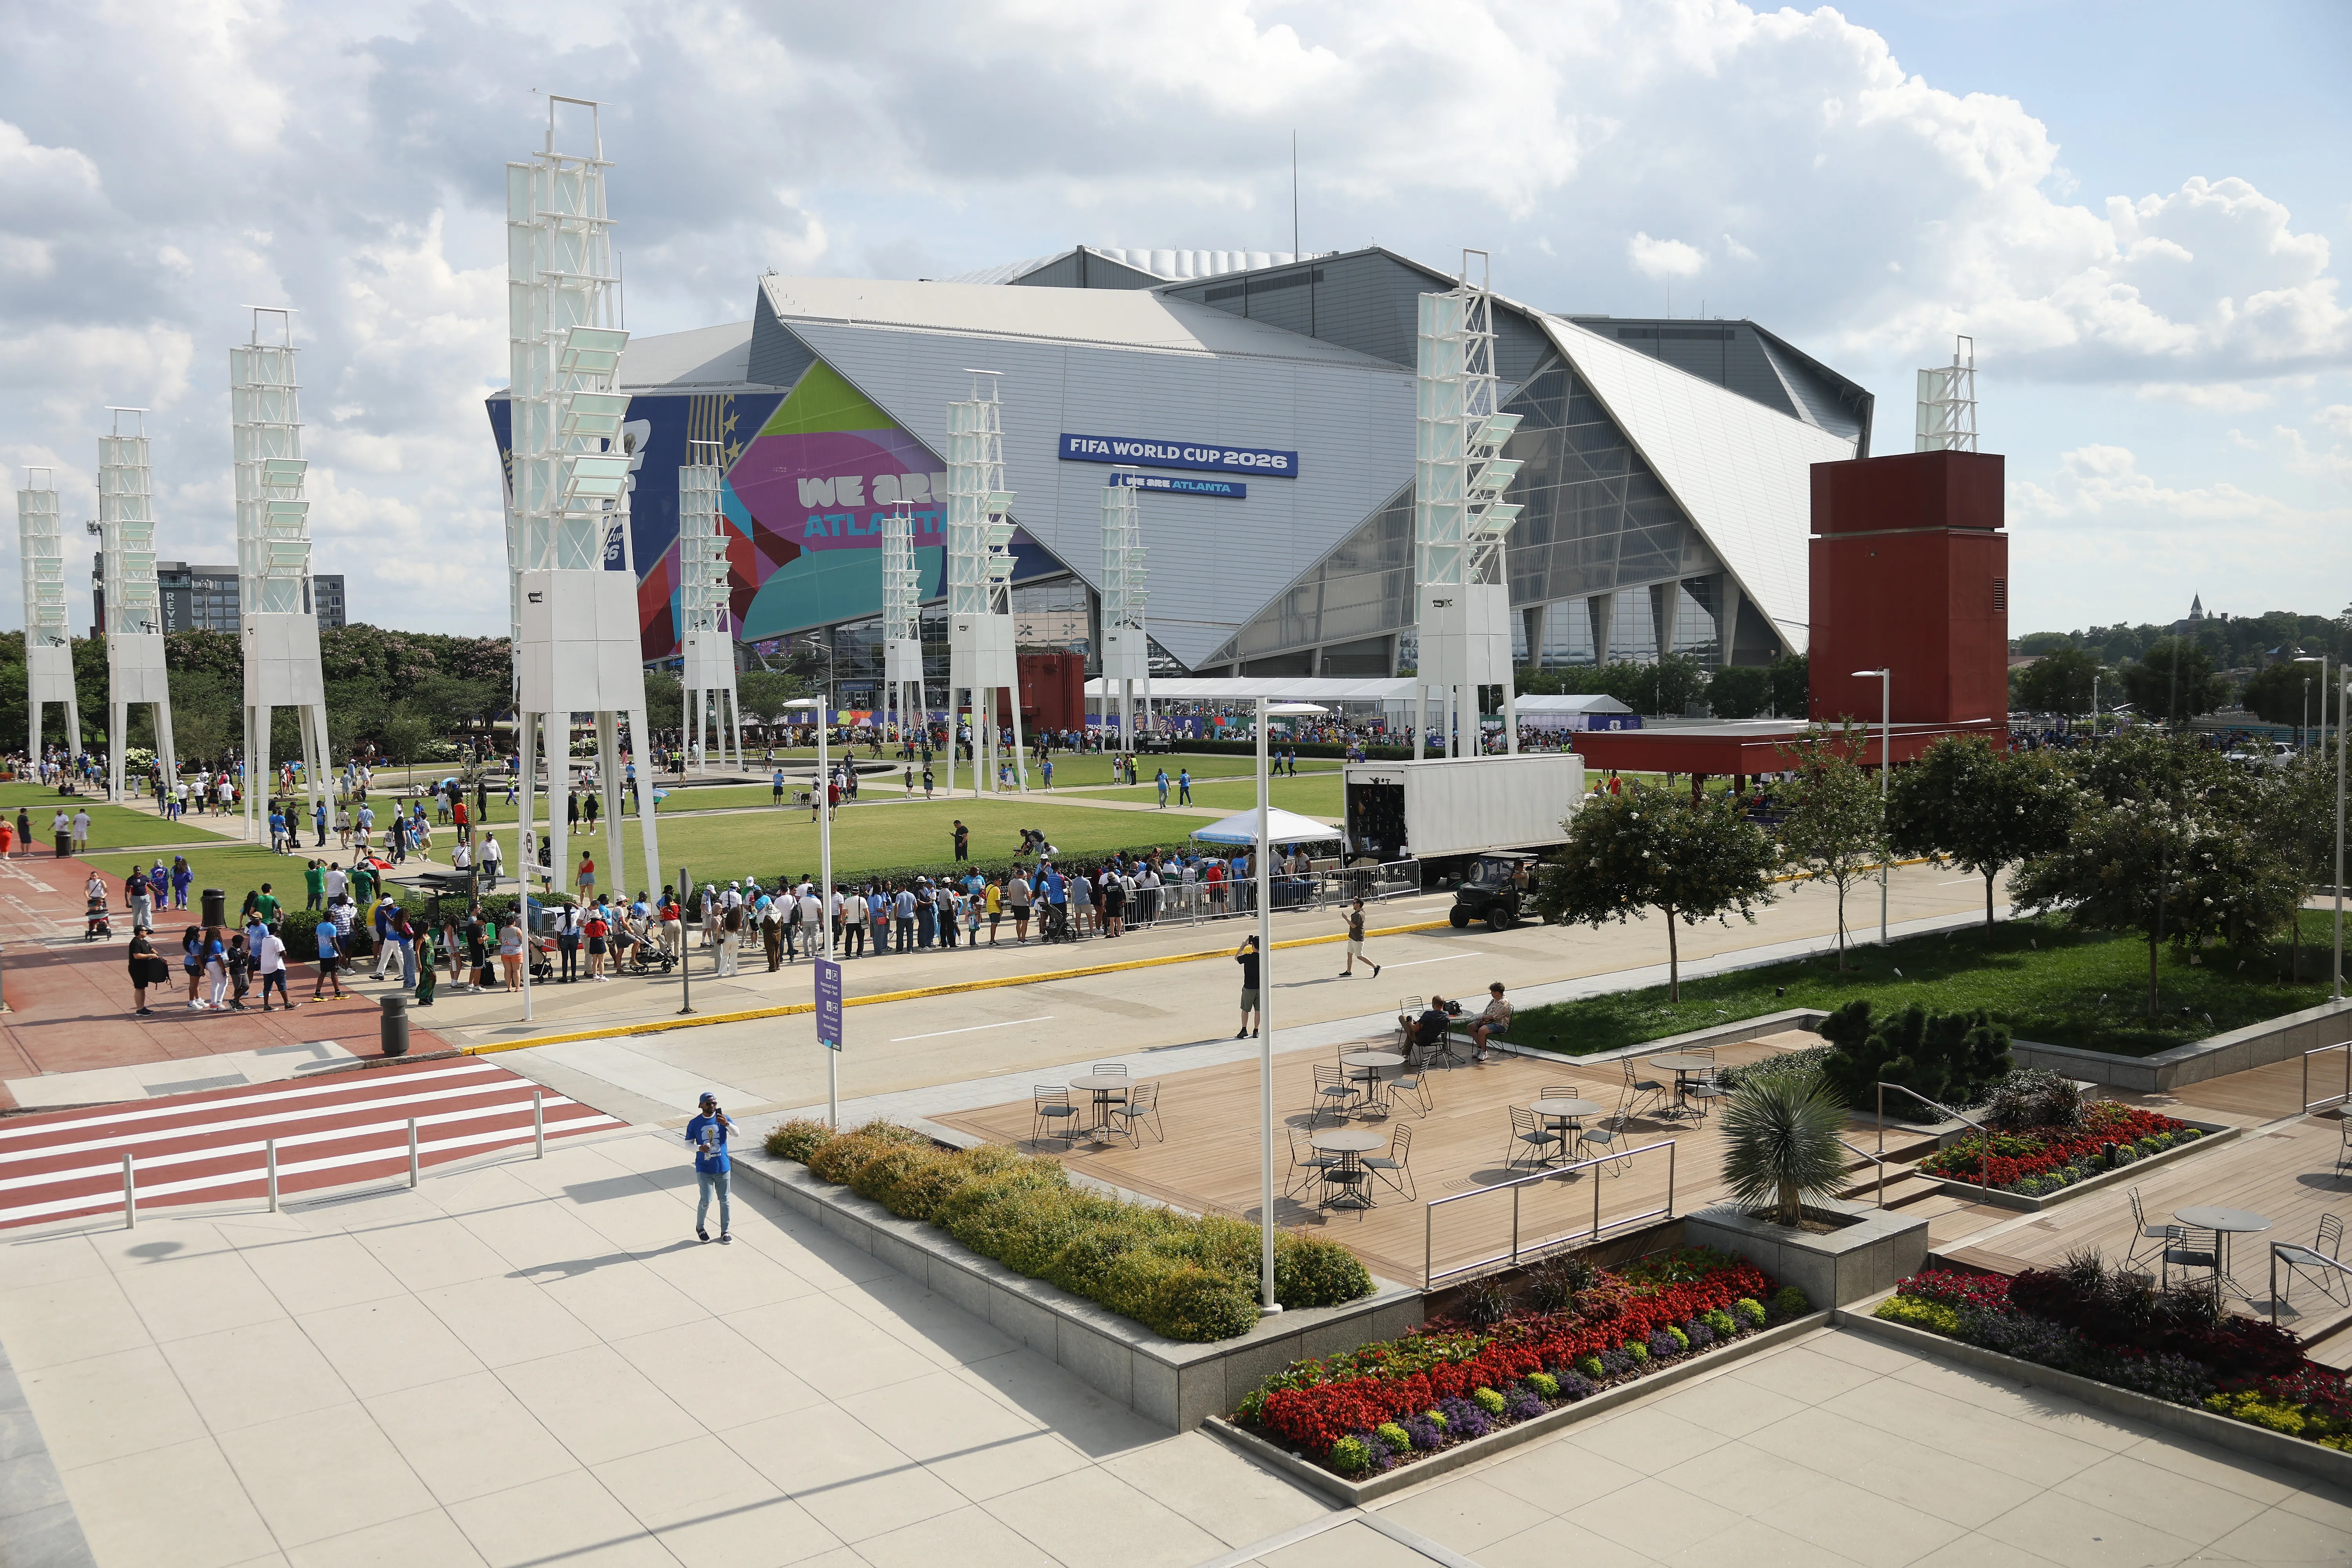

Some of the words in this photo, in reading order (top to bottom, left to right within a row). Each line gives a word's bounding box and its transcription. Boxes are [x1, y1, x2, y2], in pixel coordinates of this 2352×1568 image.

[1071, 438, 1110, 454] FIFA
[1112, 442, 1180, 459] WORLD
[1183, 448, 1220, 463] CUP
[1223, 451, 1288, 468] 2026
[798, 475, 865, 508] WE
[1126, 477, 1145, 486] WE
[1147, 479, 1171, 488] ARE
[1172, 481, 1231, 492] ATLANTA
[824, 1023, 838, 1031] Accreditation
